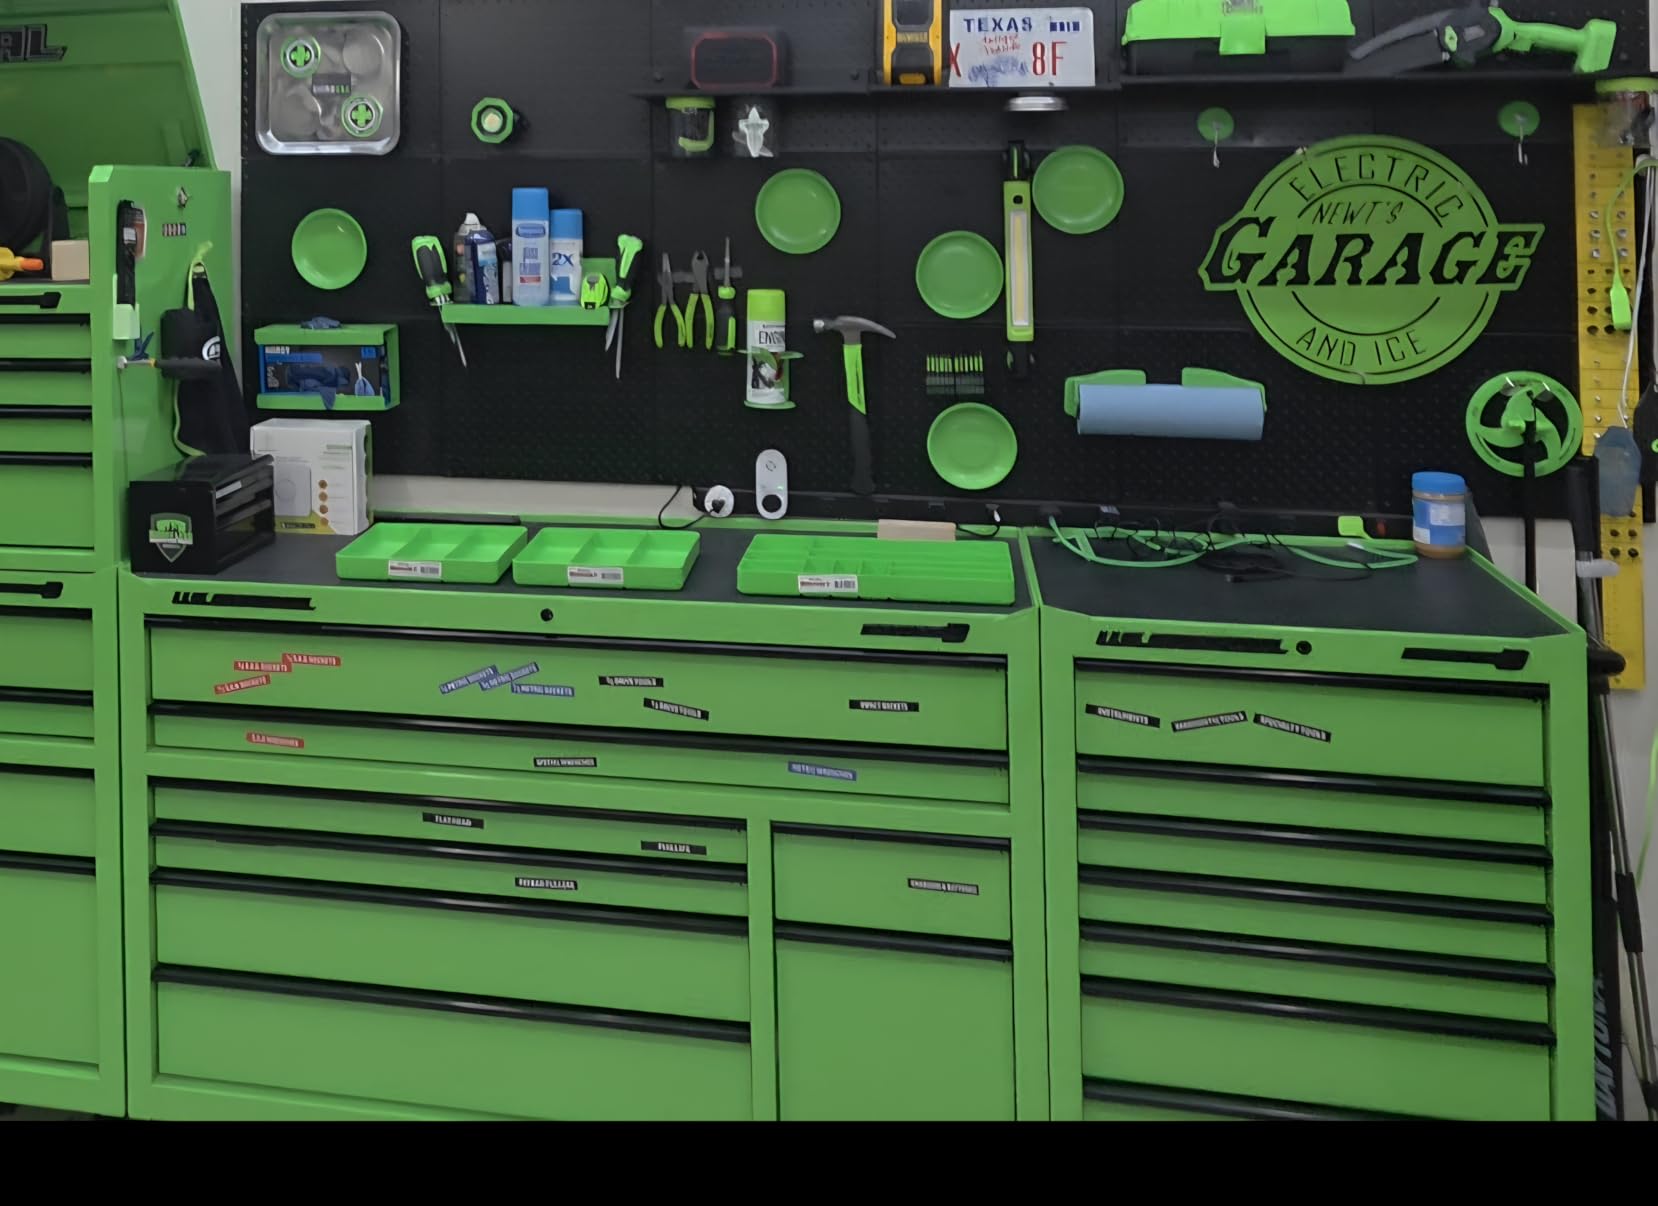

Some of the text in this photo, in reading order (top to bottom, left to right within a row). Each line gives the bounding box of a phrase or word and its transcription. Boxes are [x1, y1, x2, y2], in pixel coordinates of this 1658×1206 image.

[963, 16, 1033, 33] TEXAS
[1032, 41, 1068, 76] 8F
[1288, 153, 1465, 219] ELECTRIC
[1311, 200, 1404, 225] NEWT'S
[551, 252, 574, 267] 2X
[1205, 215, 1539, 287] GARAGE
[1295, 326, 1428, 366] AND ICE
